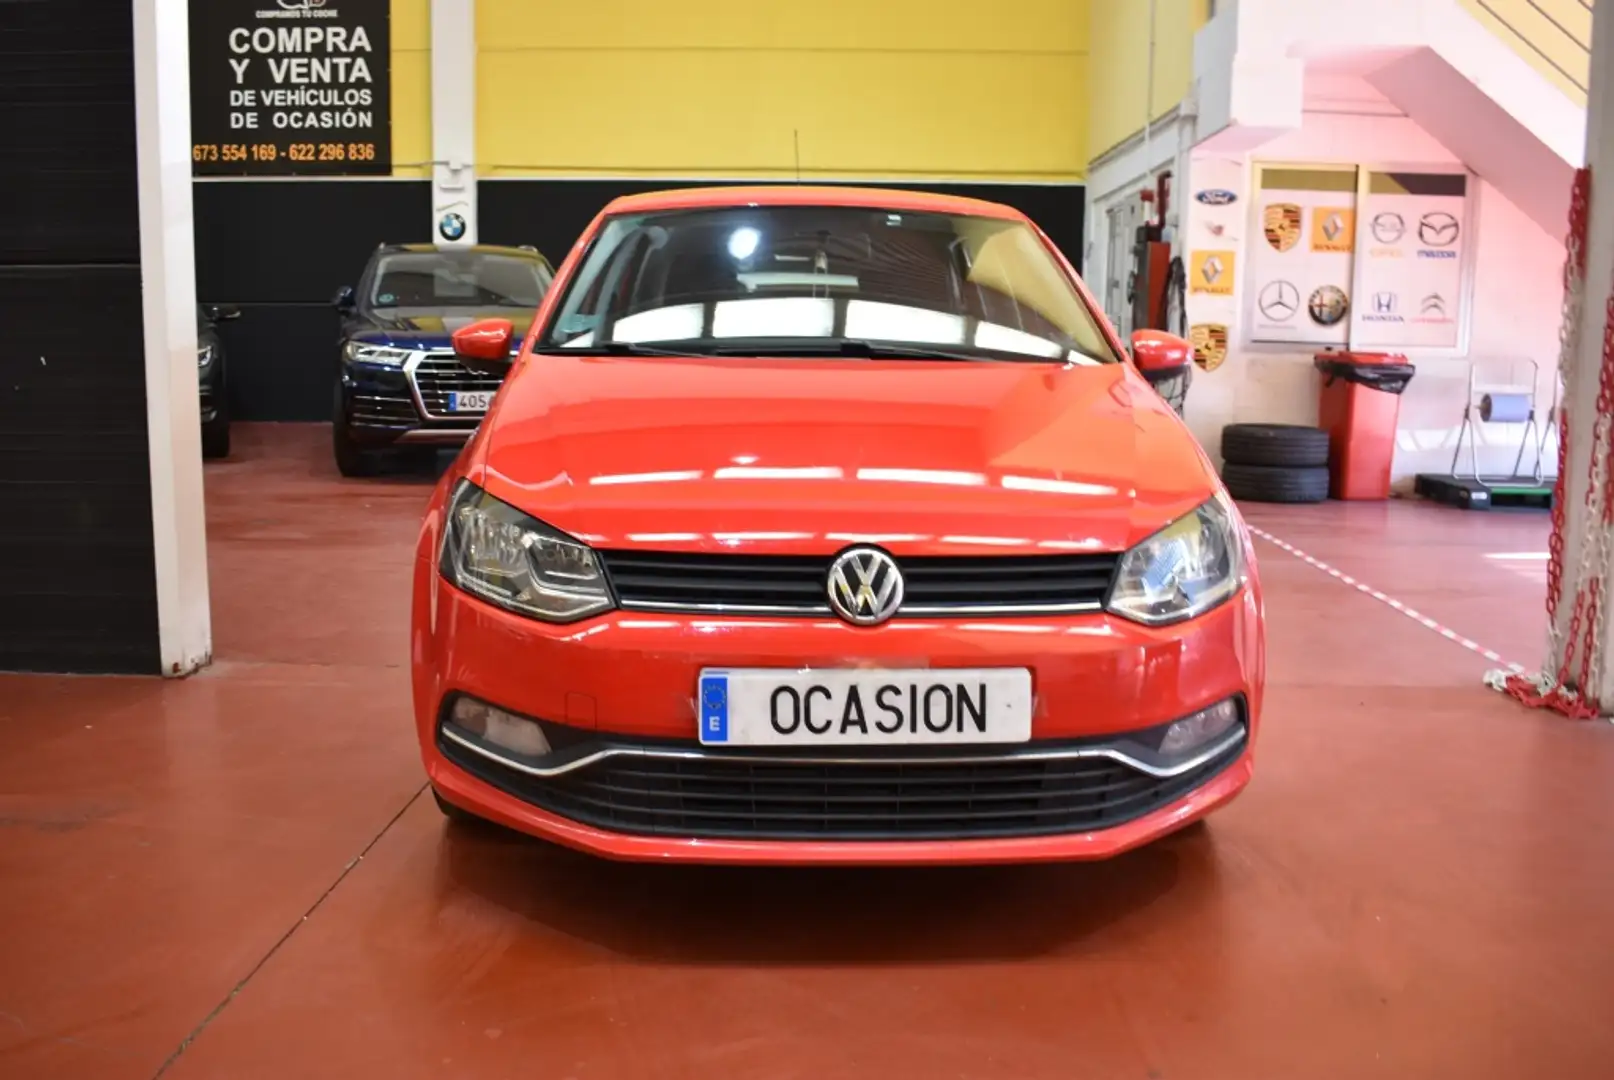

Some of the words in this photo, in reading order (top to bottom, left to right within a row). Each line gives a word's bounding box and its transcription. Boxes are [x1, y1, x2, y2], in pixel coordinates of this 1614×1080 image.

[229, 26, 372, 53] COMPRA
[229, 58, 250, 84] Y
[268, 57, 372, 83] VENTA
[230, 90, 256, 106] DE
[261, 86, 372, 106] VEHÍCULOS
[230, 112, 258, 128] DE
[273, 108, 372, 128] OCASIÓN
[193, 145, 218, 160] 673
[222, 145, 247, 160] 554
[252, 145, 276, 160] 169
[289, 144, 314, 160] 622
[319, 144, 344, 160] 296
[348, 144, 375, 160] 836
[769, 683, 987, 735] OCASION
[709, 715, 720, 732] E
